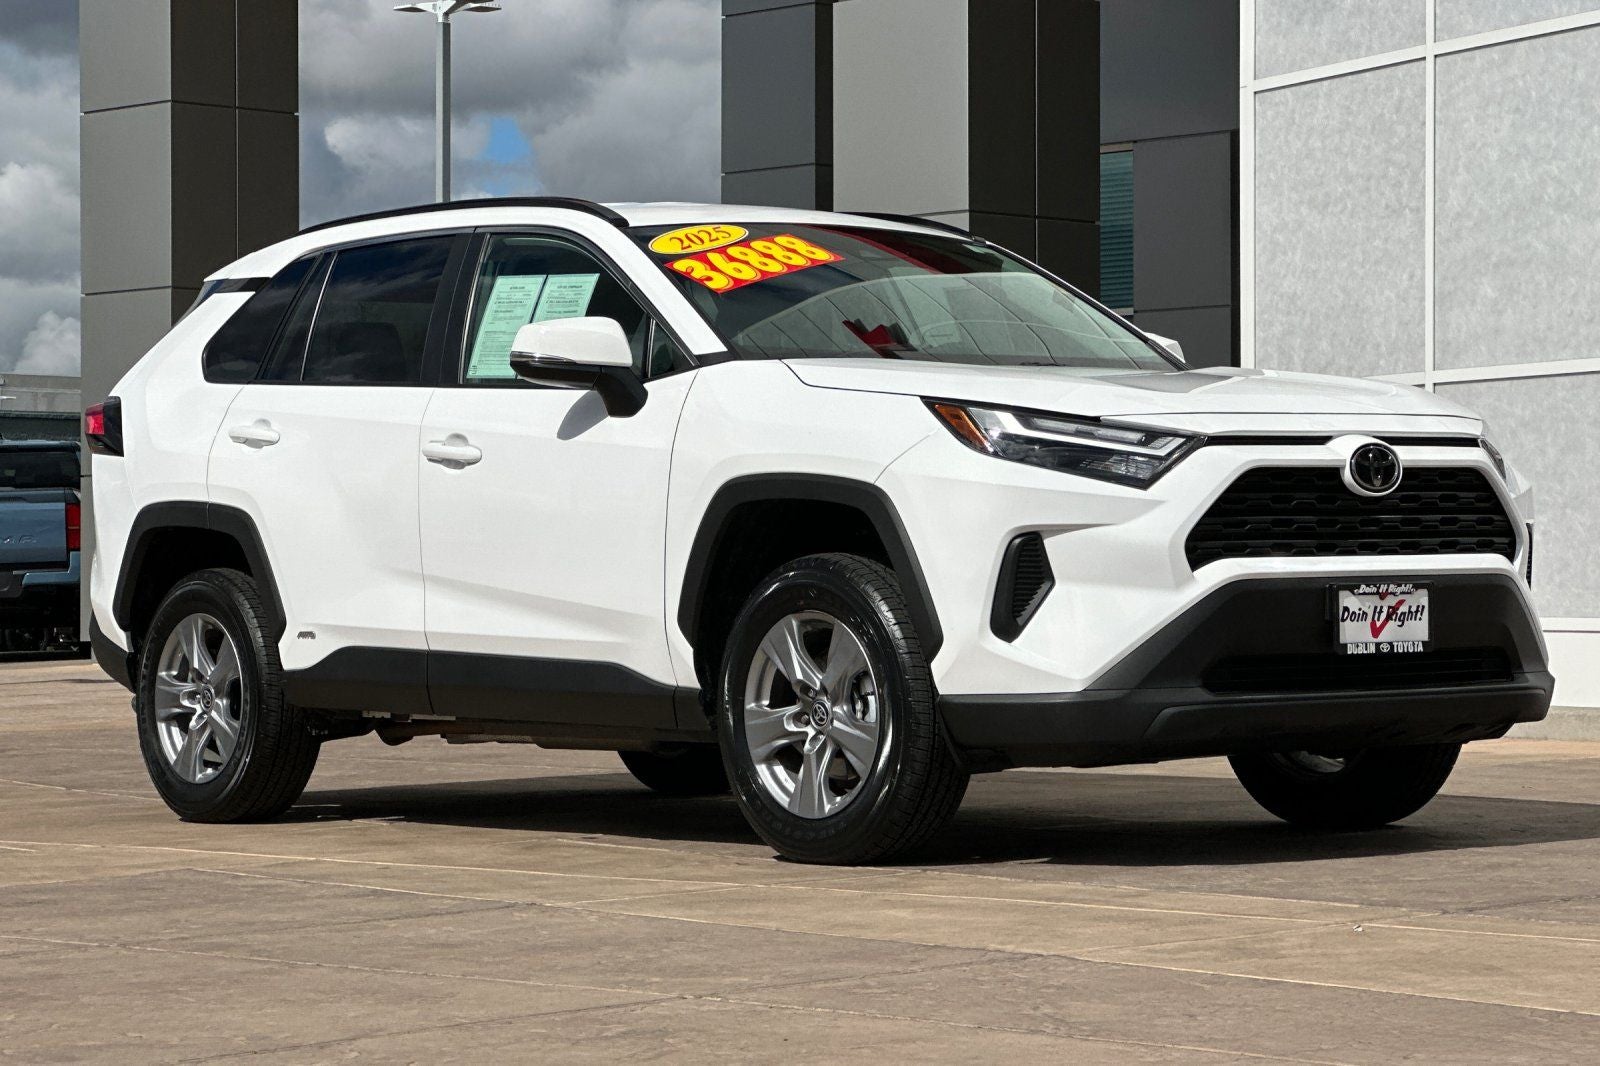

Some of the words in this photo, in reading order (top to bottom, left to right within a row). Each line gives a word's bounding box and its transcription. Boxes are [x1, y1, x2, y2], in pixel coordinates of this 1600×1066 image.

[669, 226, 732, 251] 2025
[672, 236, 835, 290] 36888
[1388, 584, 1413, 596] Right!
[1371, 605, 1384, 622] It
[1385, 604, 1425, 628] Right!
[1347, 643, 1376, 654] DUBLIN
[1393, 641, 1424, 653] TOYOTA
